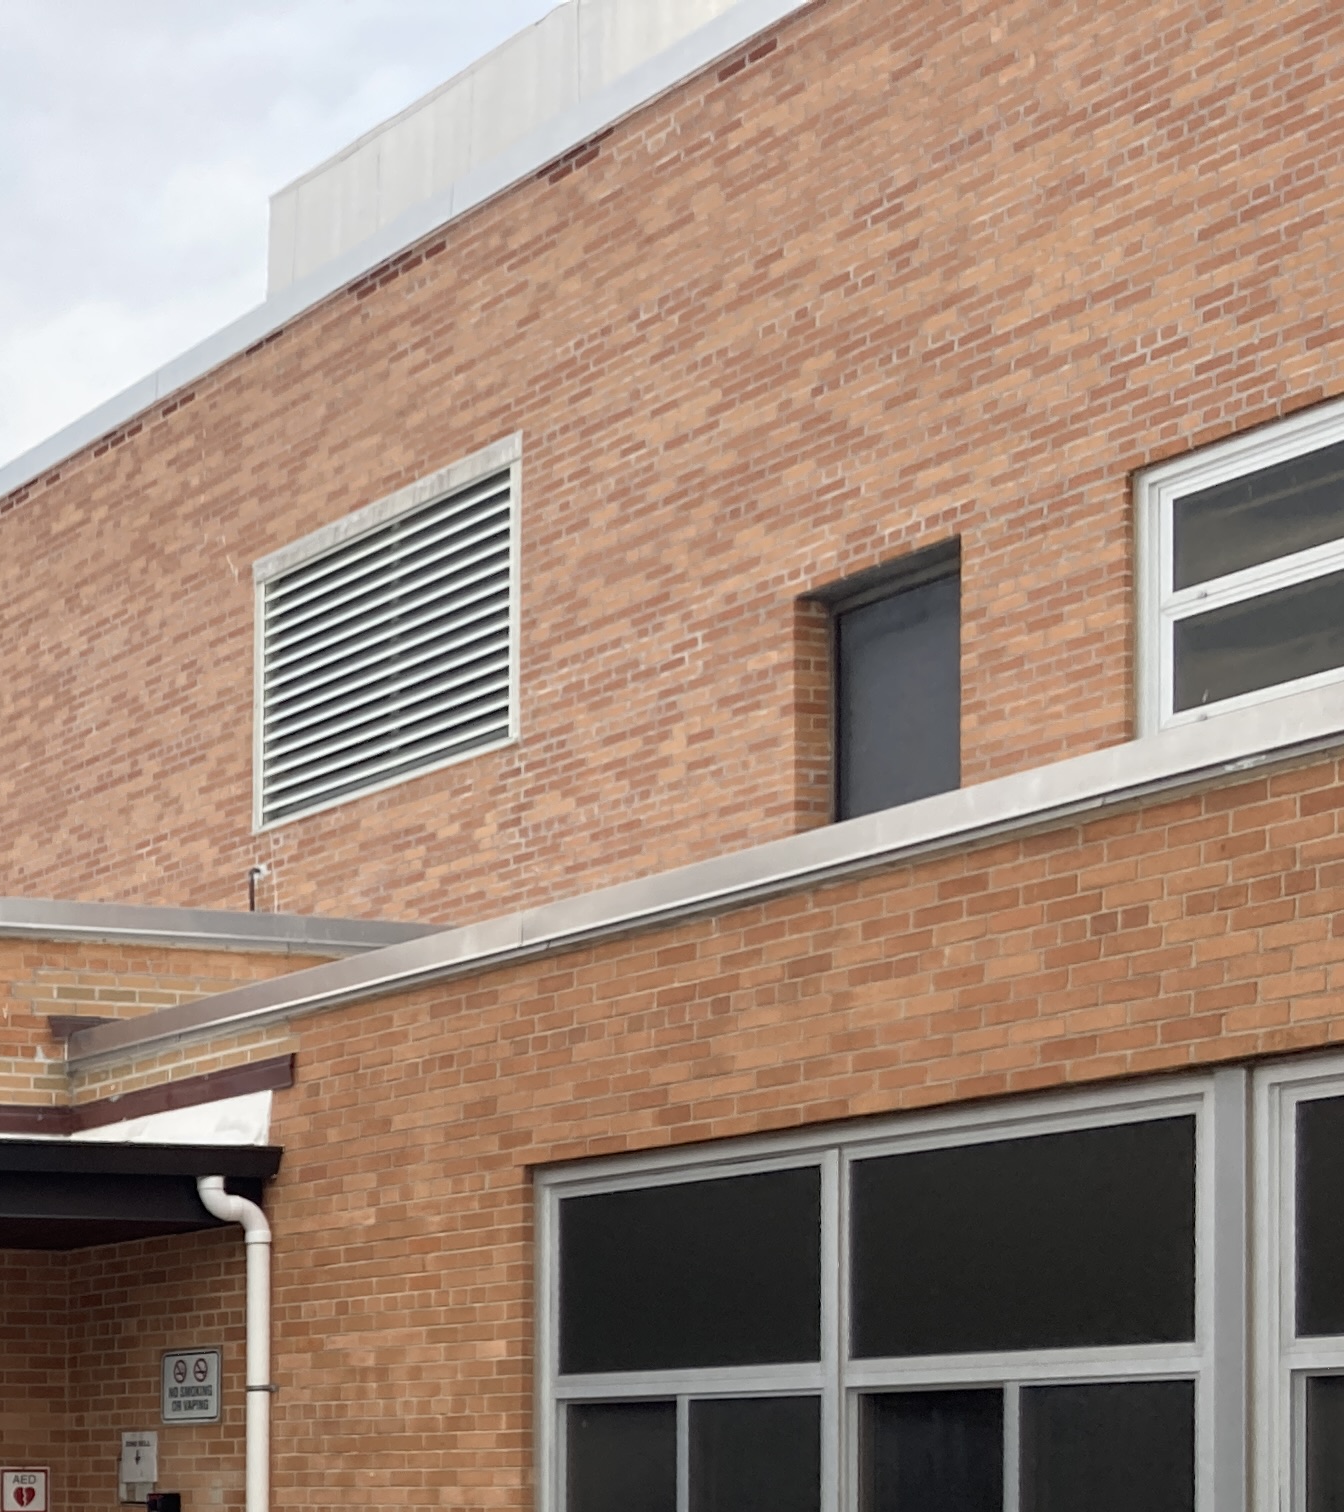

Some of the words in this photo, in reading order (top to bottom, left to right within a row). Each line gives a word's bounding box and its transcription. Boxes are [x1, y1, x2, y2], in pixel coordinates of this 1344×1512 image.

[180, 1385, 212, 1398] SMOKING
[183, 1399, 209, 1411] VAPING
[12, 1474, 37, 1485] AED
